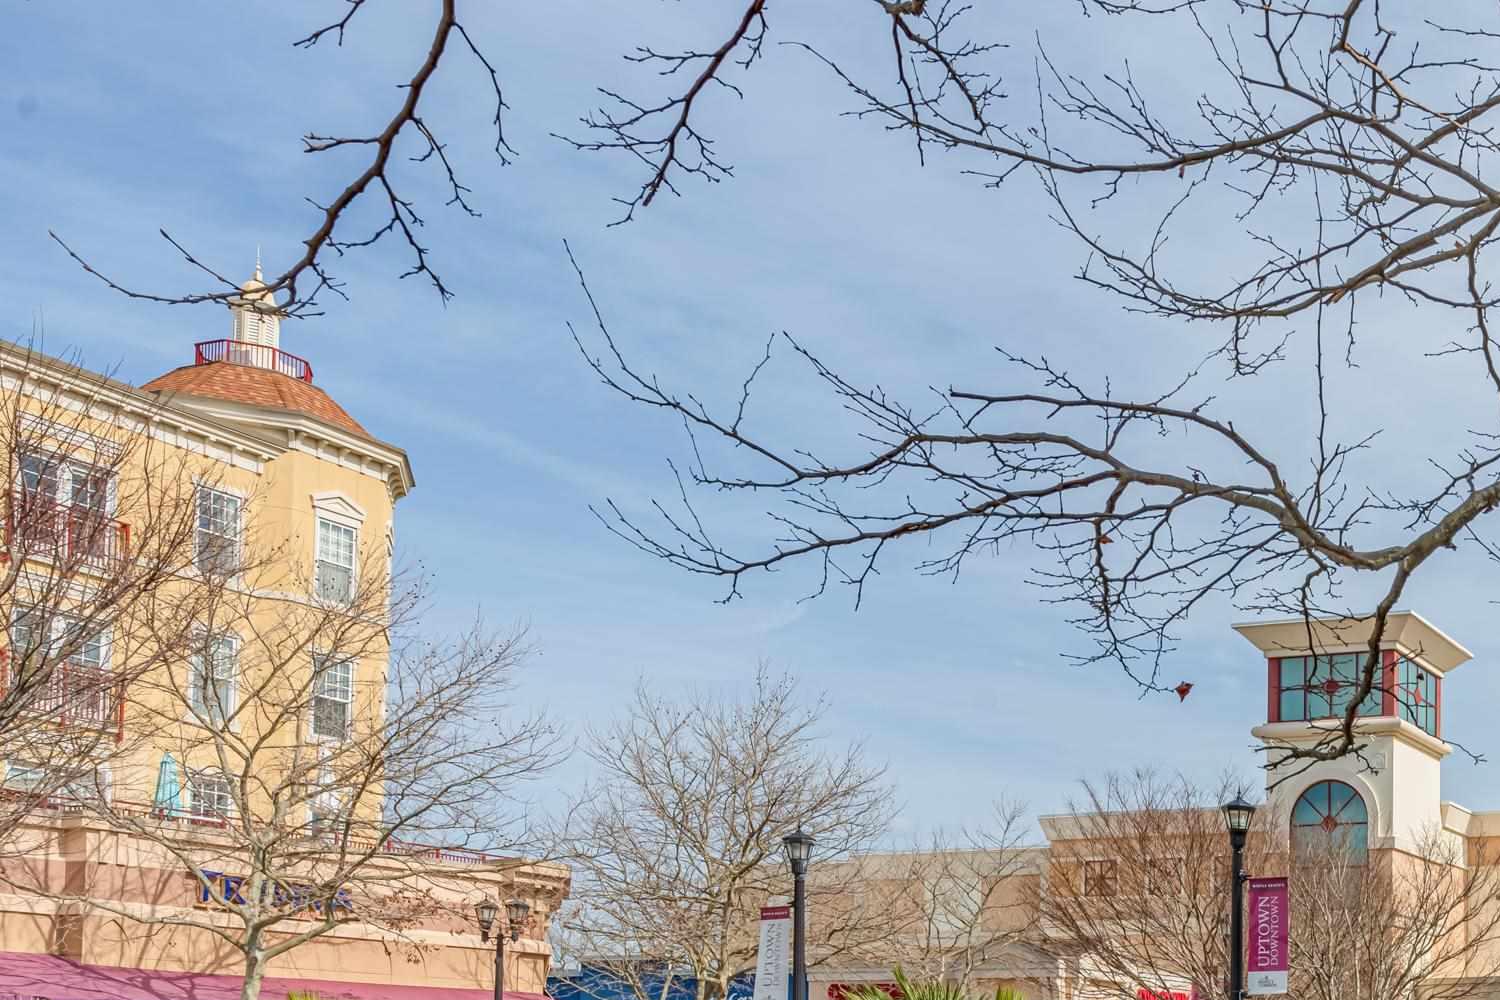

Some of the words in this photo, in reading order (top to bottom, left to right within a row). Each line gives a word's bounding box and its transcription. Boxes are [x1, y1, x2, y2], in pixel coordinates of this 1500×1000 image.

[761, 922, 776, 988] UPTOWN
[1258, 896, 1270, 967] UPTOWN
[1270, 896, 1280, 966] DOWNTOWN
